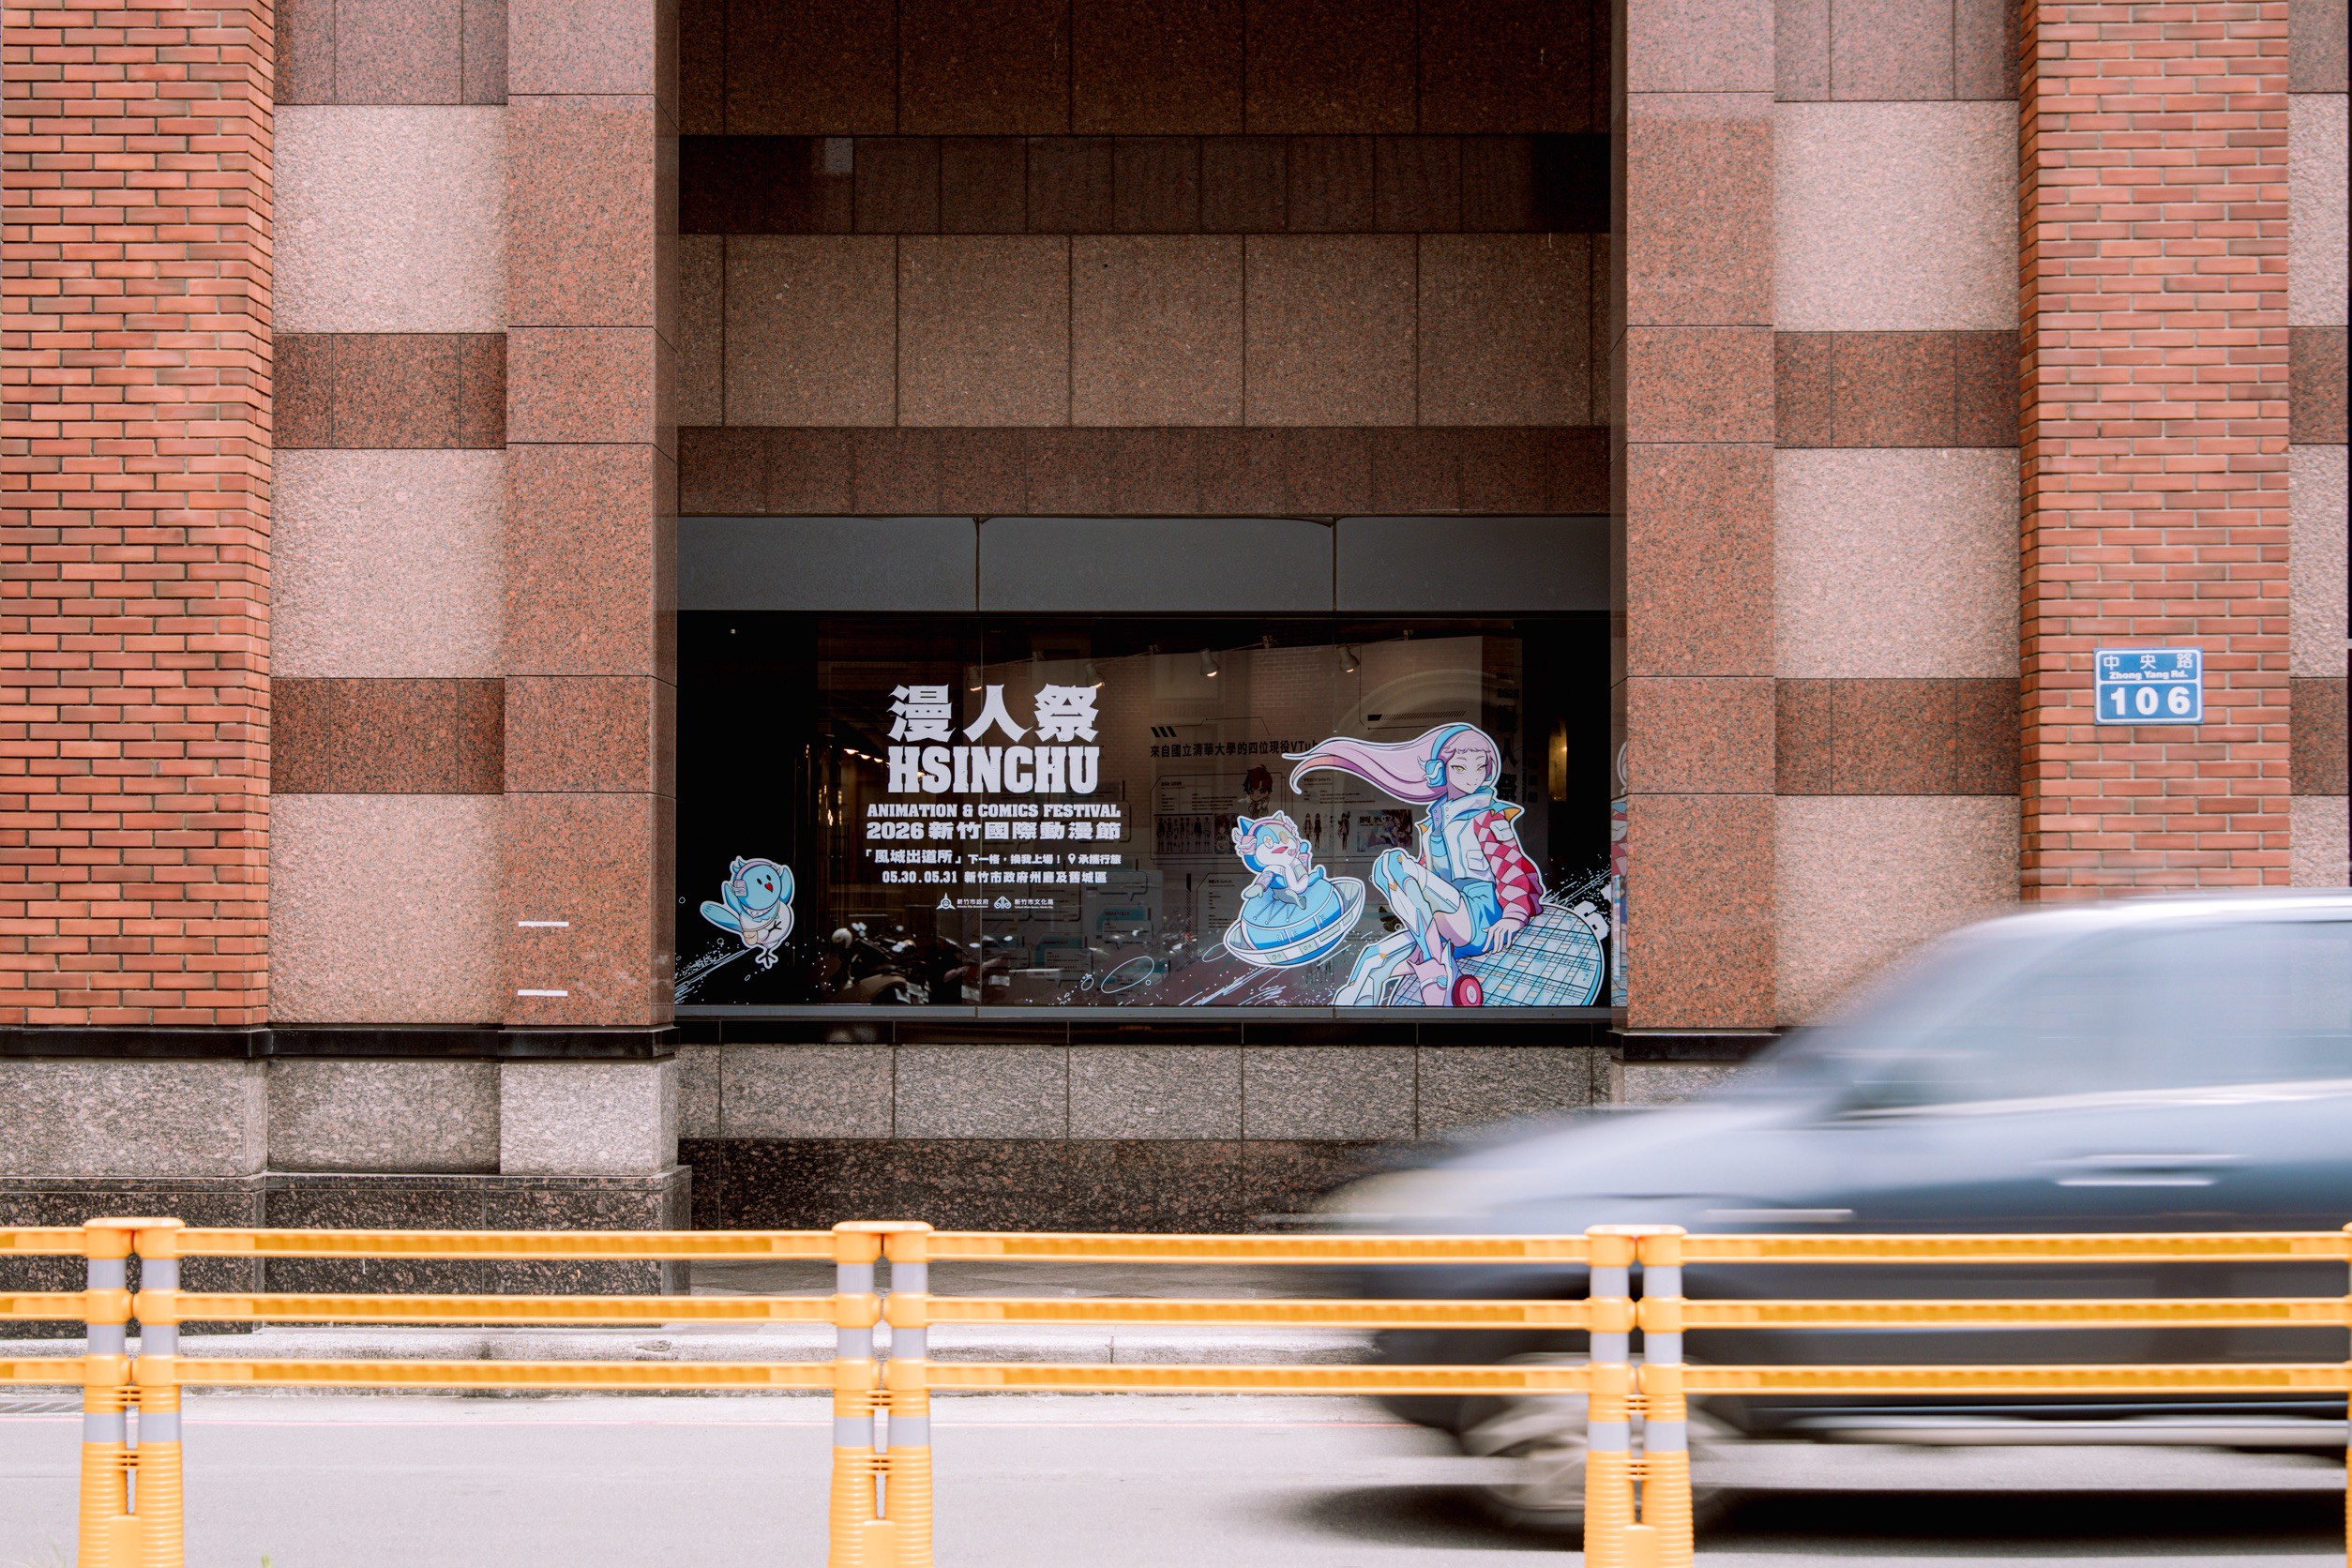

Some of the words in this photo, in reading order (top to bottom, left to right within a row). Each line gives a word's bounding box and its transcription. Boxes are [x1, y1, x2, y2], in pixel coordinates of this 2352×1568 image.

[2103, 653, 2193, 670] 中央路
[2109, 671, 2142, 680] Zhong
[2144, 671, 2169, 680] Yang
[2171, 670, 2188, 678] Rd.
[2111, 686, 2191, 716] 106
[886, 683, 1099, 743] 漫人祭
[887, 746, 1099, 794] HSINCHU
[867, 804, 957, 817] ANIMATION
[962, 804, 973, 817] &
[978, 804, 1038, 818] COMICS
[1043, 804, 1121, 818] FESTIVAL
